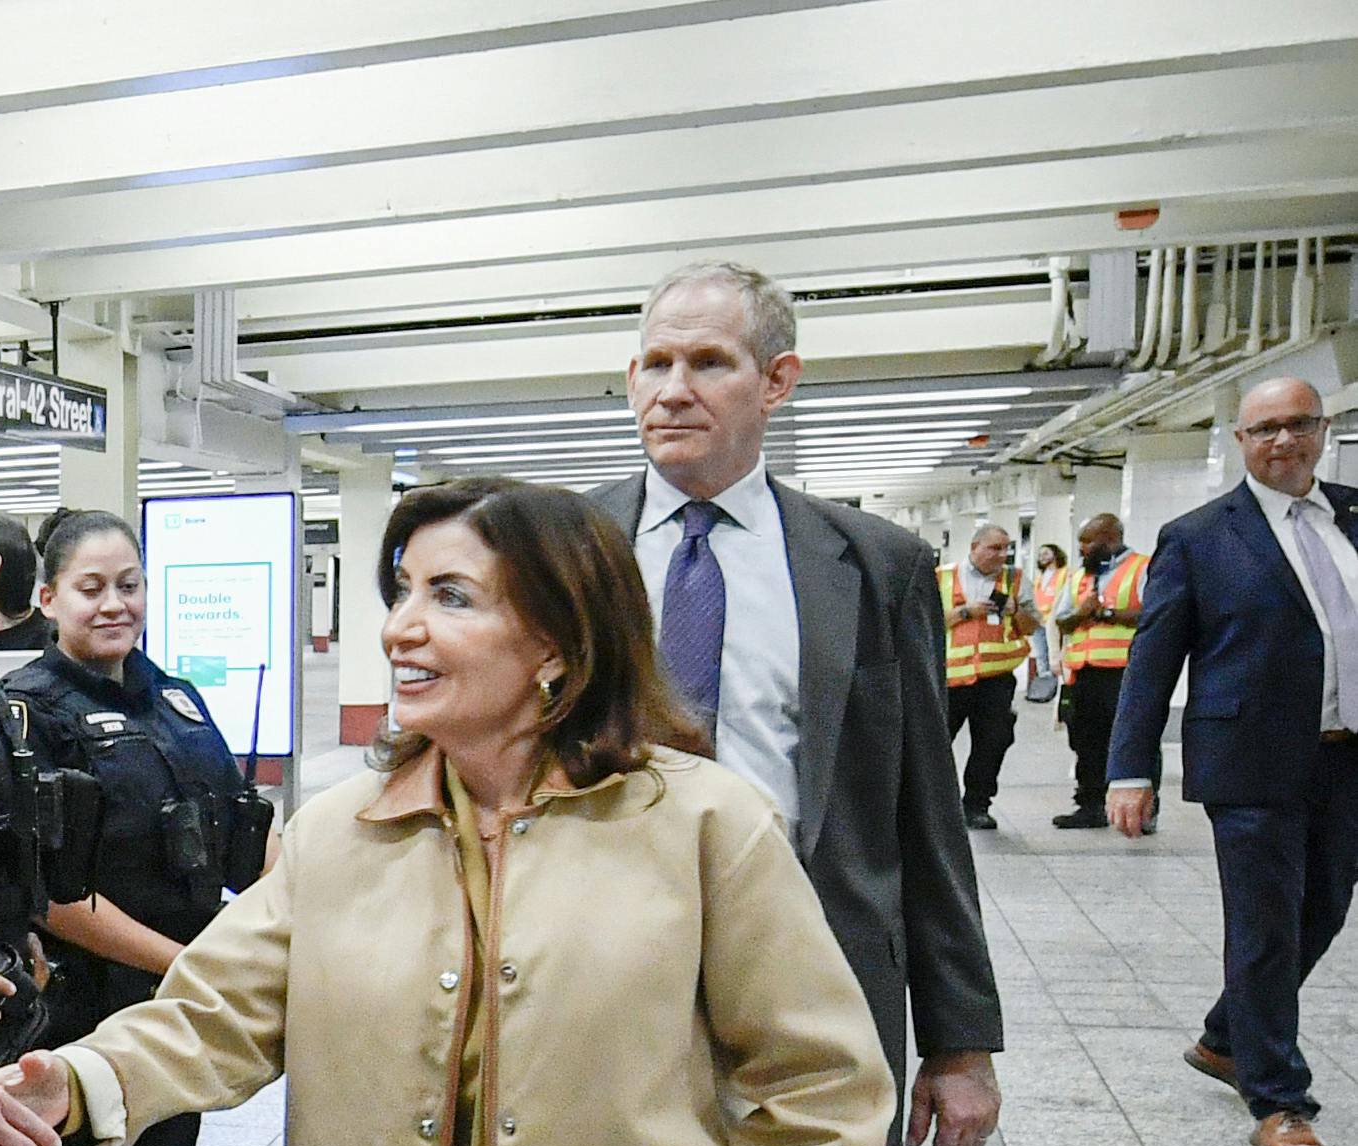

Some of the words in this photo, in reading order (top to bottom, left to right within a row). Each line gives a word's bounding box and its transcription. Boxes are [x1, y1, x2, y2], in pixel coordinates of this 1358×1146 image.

[49, 386, 94, 434] Street
[178, 592, 232, 605] Double
[178, 609, 243, 621] rewards.
